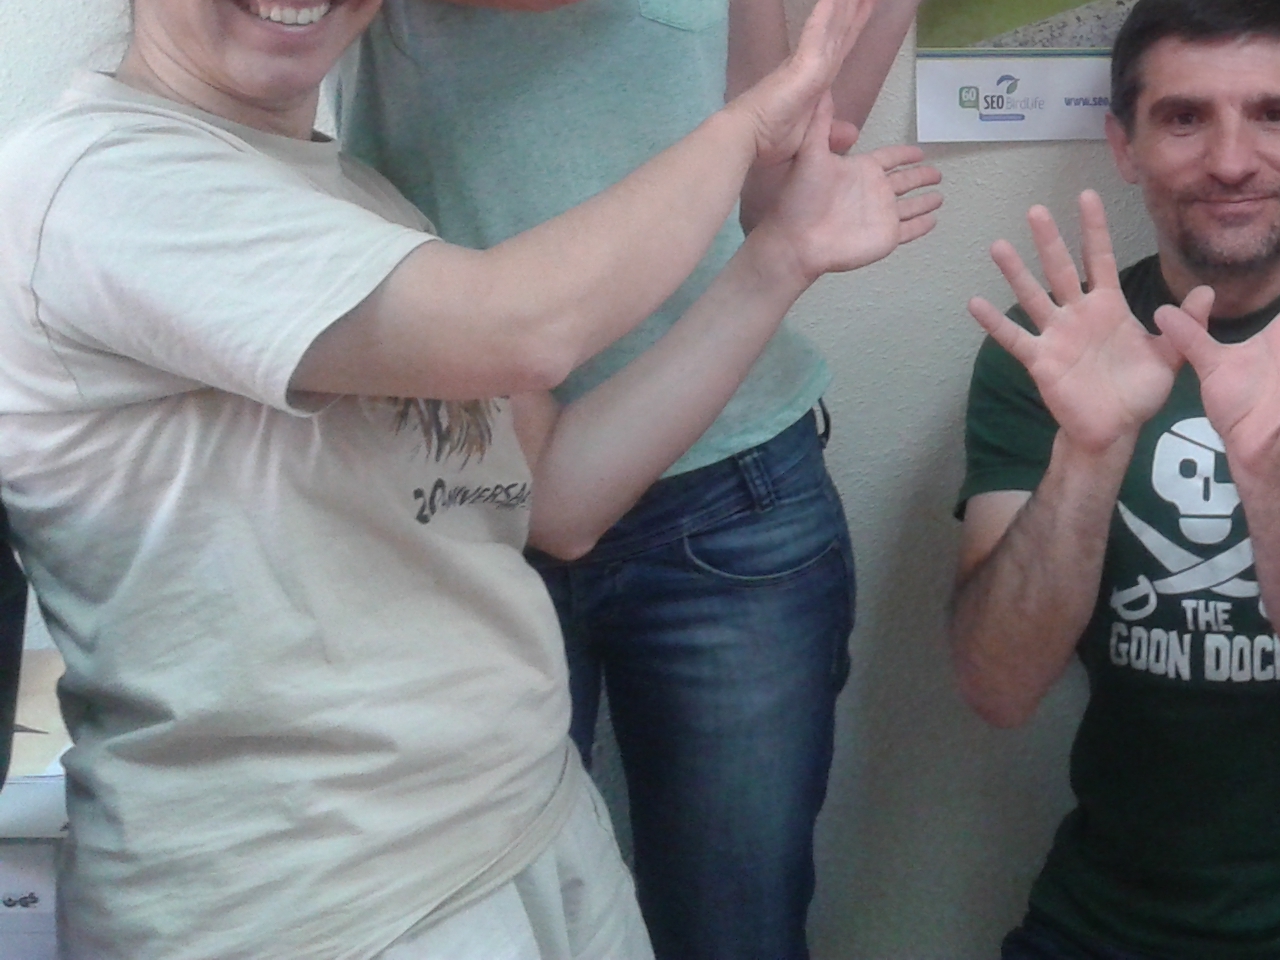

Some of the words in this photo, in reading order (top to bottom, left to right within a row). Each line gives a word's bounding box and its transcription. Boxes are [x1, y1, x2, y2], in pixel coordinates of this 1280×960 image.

[983, 94, 1005, 110] SEO
[1064, 97, 1110, 107] www.seo
[1180, 599, 1233, 632] THE
[1110, 622, 1191, 681] GOON
